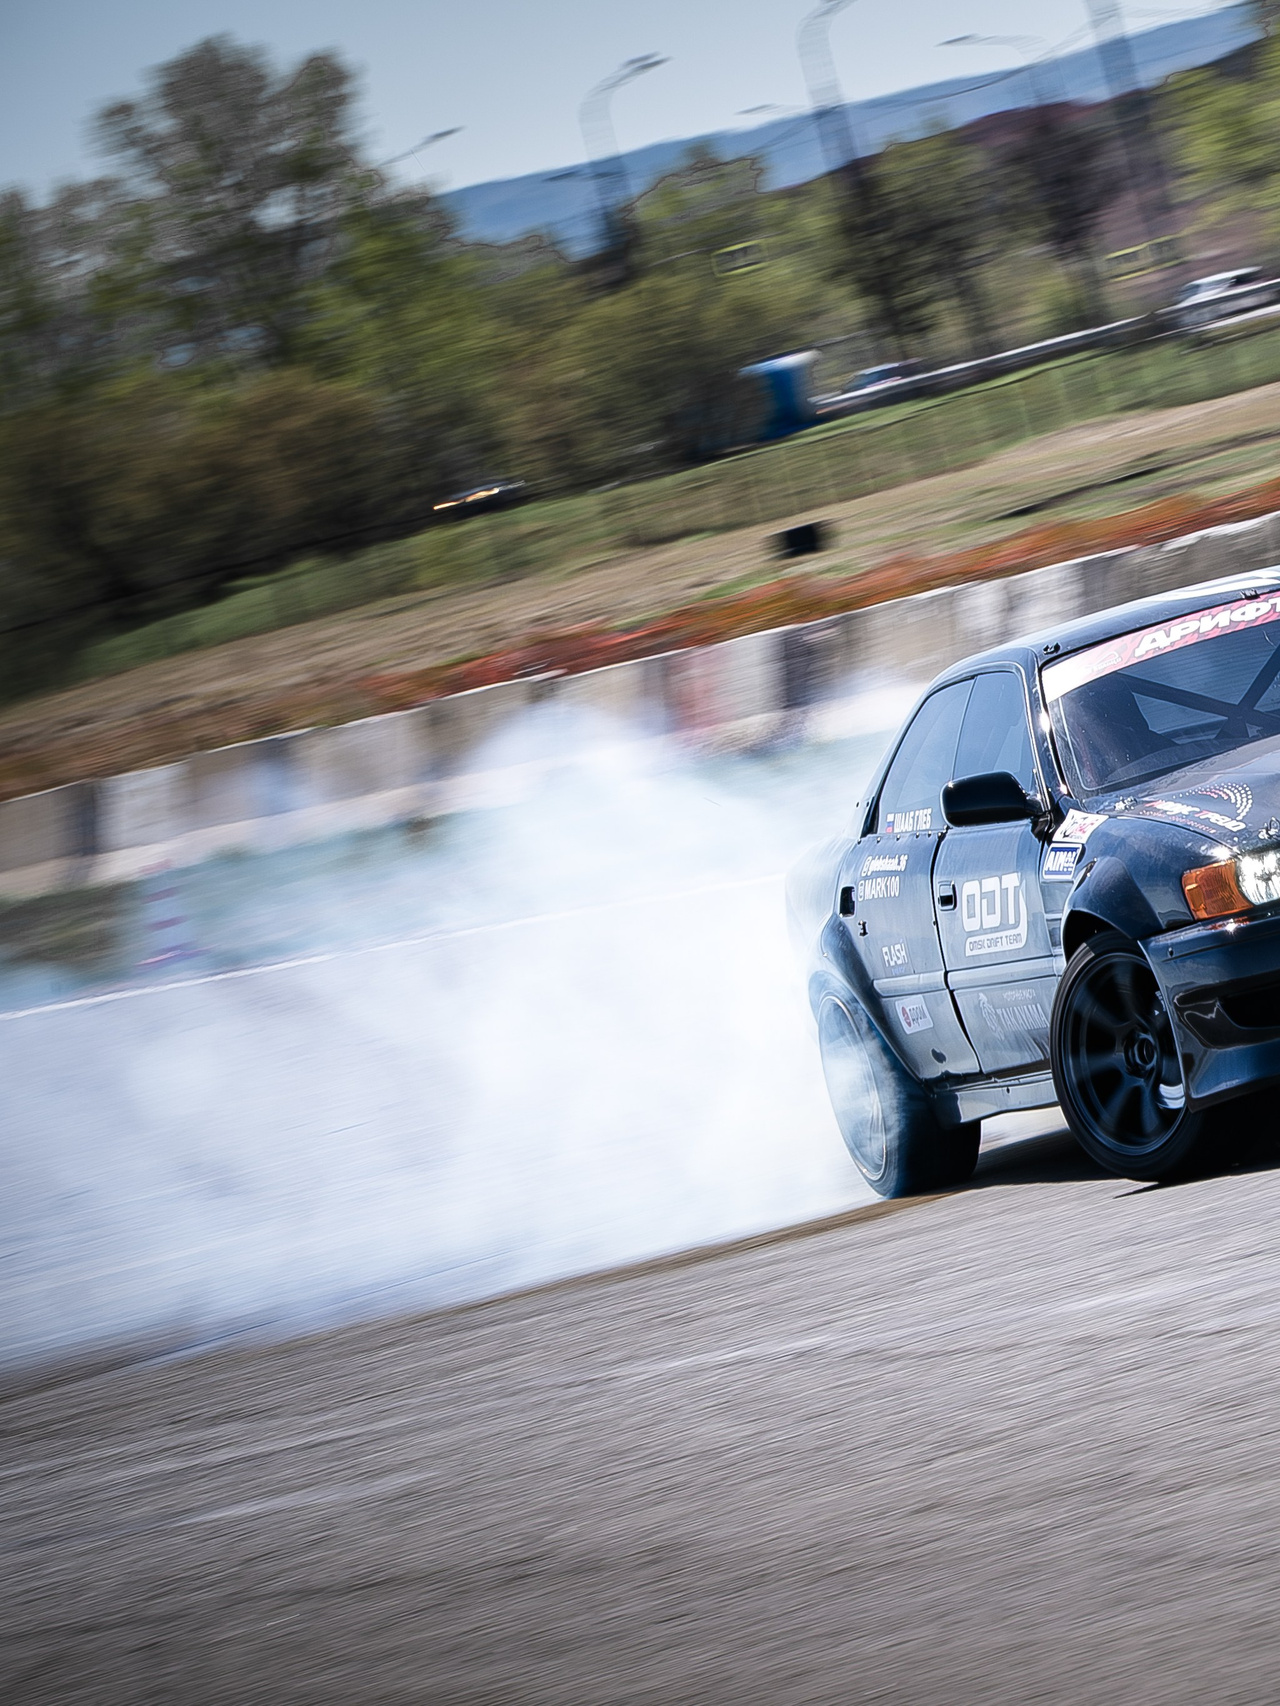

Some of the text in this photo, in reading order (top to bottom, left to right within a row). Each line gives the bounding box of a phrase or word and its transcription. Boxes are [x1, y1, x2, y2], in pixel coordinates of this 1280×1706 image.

[858, 875, 900, 902] @MARK100
[961, 872, 1020, 932] ODT
[881, 943, 908, 968] FLASH
[968, 932, 1023, 952] OMSK DRIFT TEAM
[996, 1003, 1051, 1032] TAKAYAMA
